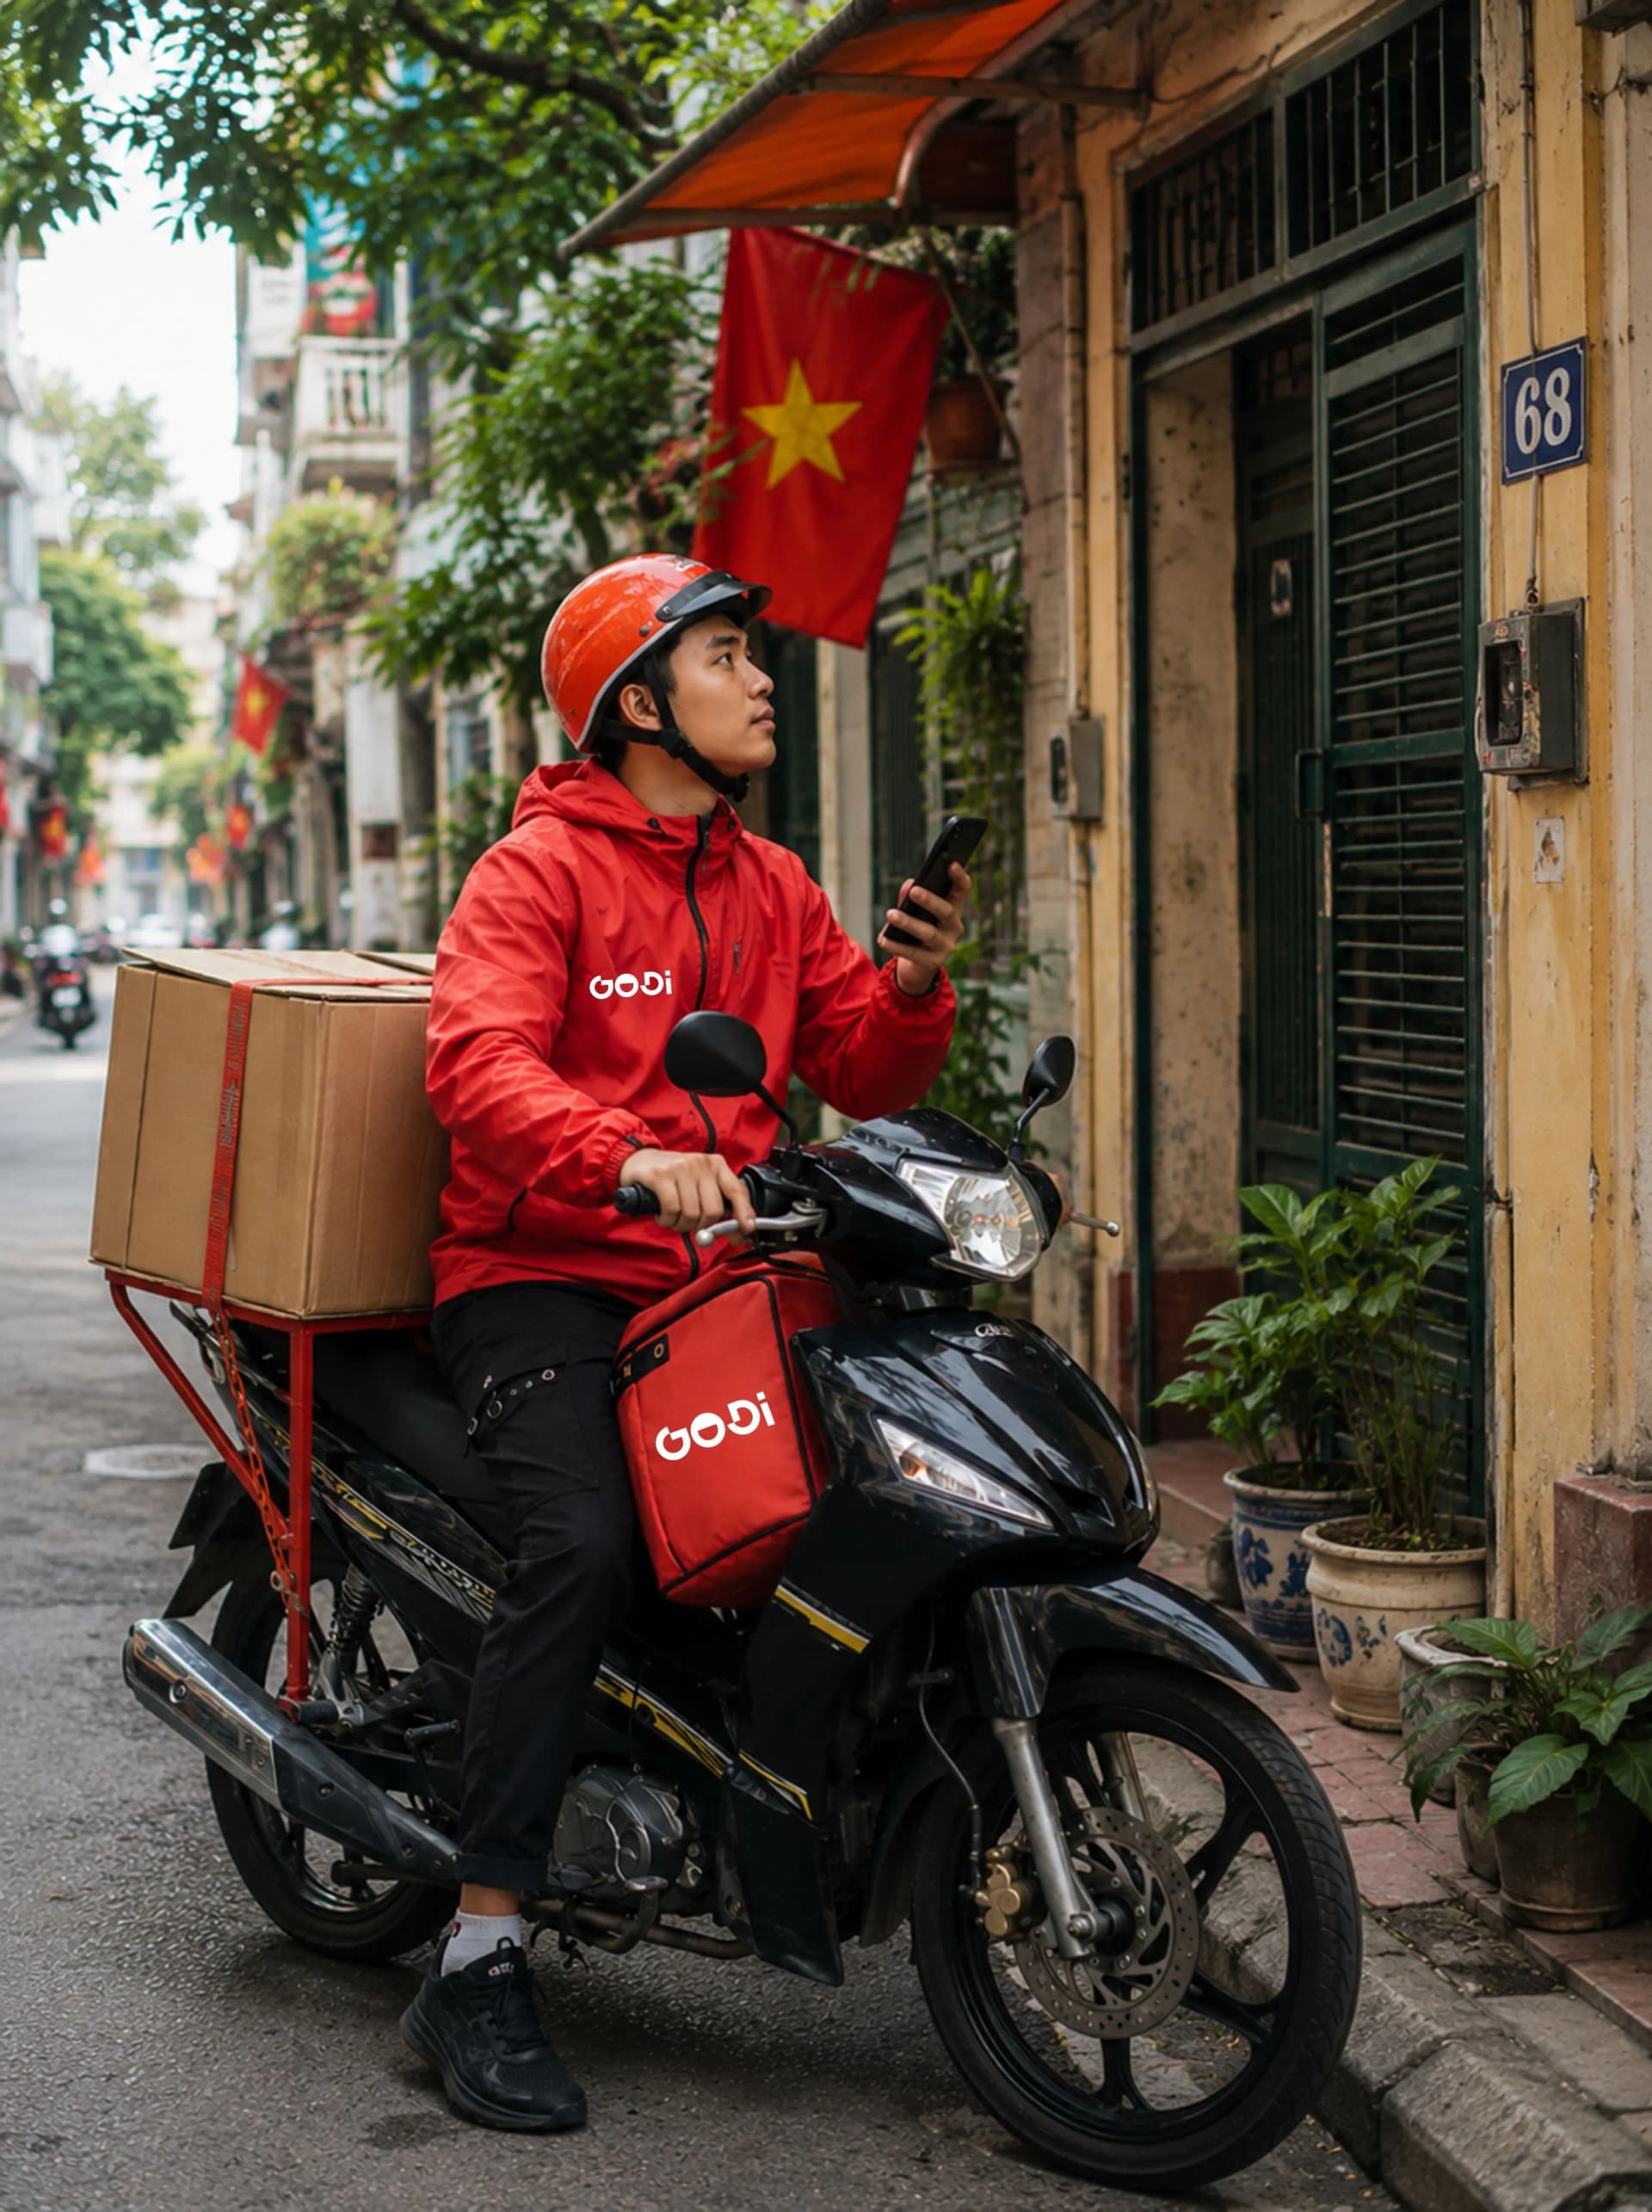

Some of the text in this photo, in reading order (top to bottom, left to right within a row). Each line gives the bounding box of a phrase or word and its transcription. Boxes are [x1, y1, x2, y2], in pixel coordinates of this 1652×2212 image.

[1515, 367, 1572, 455] 68
[589, 970, 673, 1000] GODi
[655, 1390, 776, 1461] GODi
